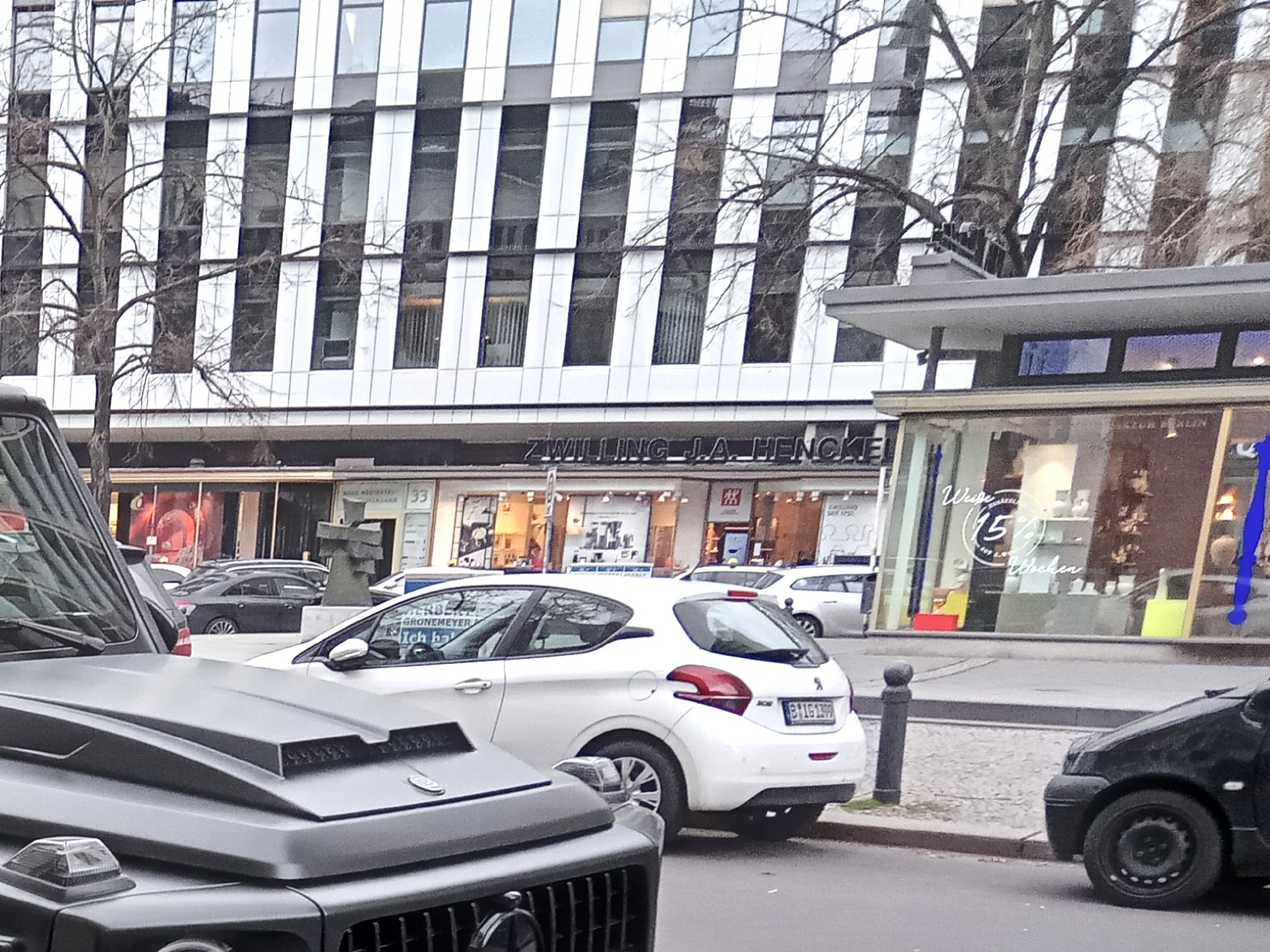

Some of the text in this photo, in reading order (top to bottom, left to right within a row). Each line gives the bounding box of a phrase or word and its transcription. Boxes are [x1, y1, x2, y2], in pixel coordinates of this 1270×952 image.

[524, 437, 670, 463] ZWILLING
[683, 437, 738, 463] J.A.
[411, 489, 428, 503] 33
[1008, 555, 1083, 576] Wochen
